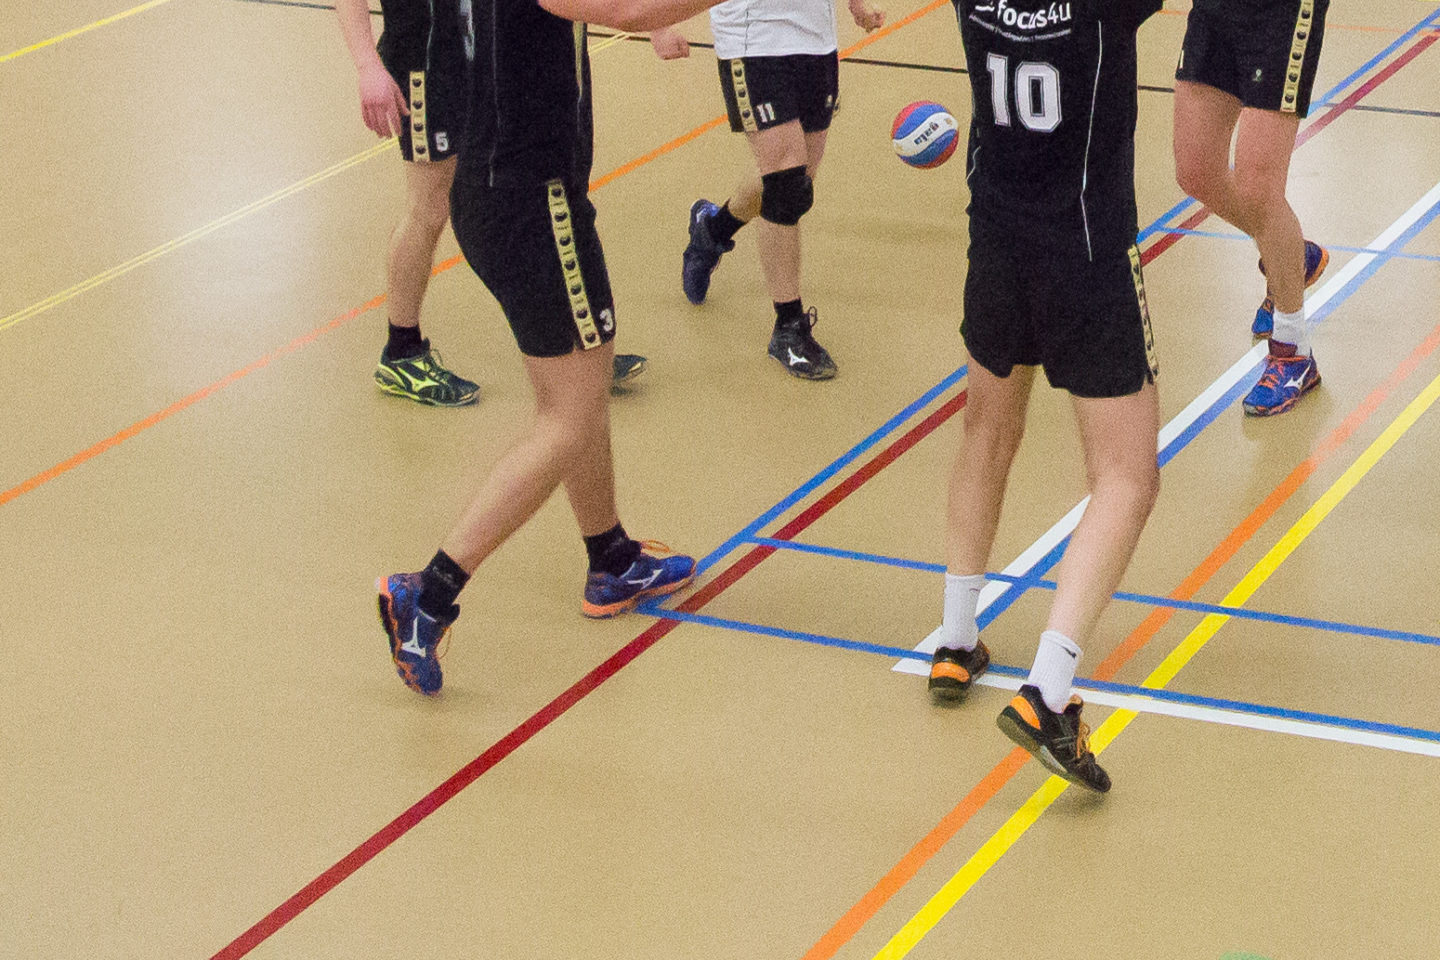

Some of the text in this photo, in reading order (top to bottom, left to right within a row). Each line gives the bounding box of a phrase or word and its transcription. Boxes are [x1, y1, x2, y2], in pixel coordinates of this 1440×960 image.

[986, 51, 1063, 134] 10
[757, 102, 776, 123] 11
[434, 131, 449, 154] 5
[600, 308, 614, 332] 3
